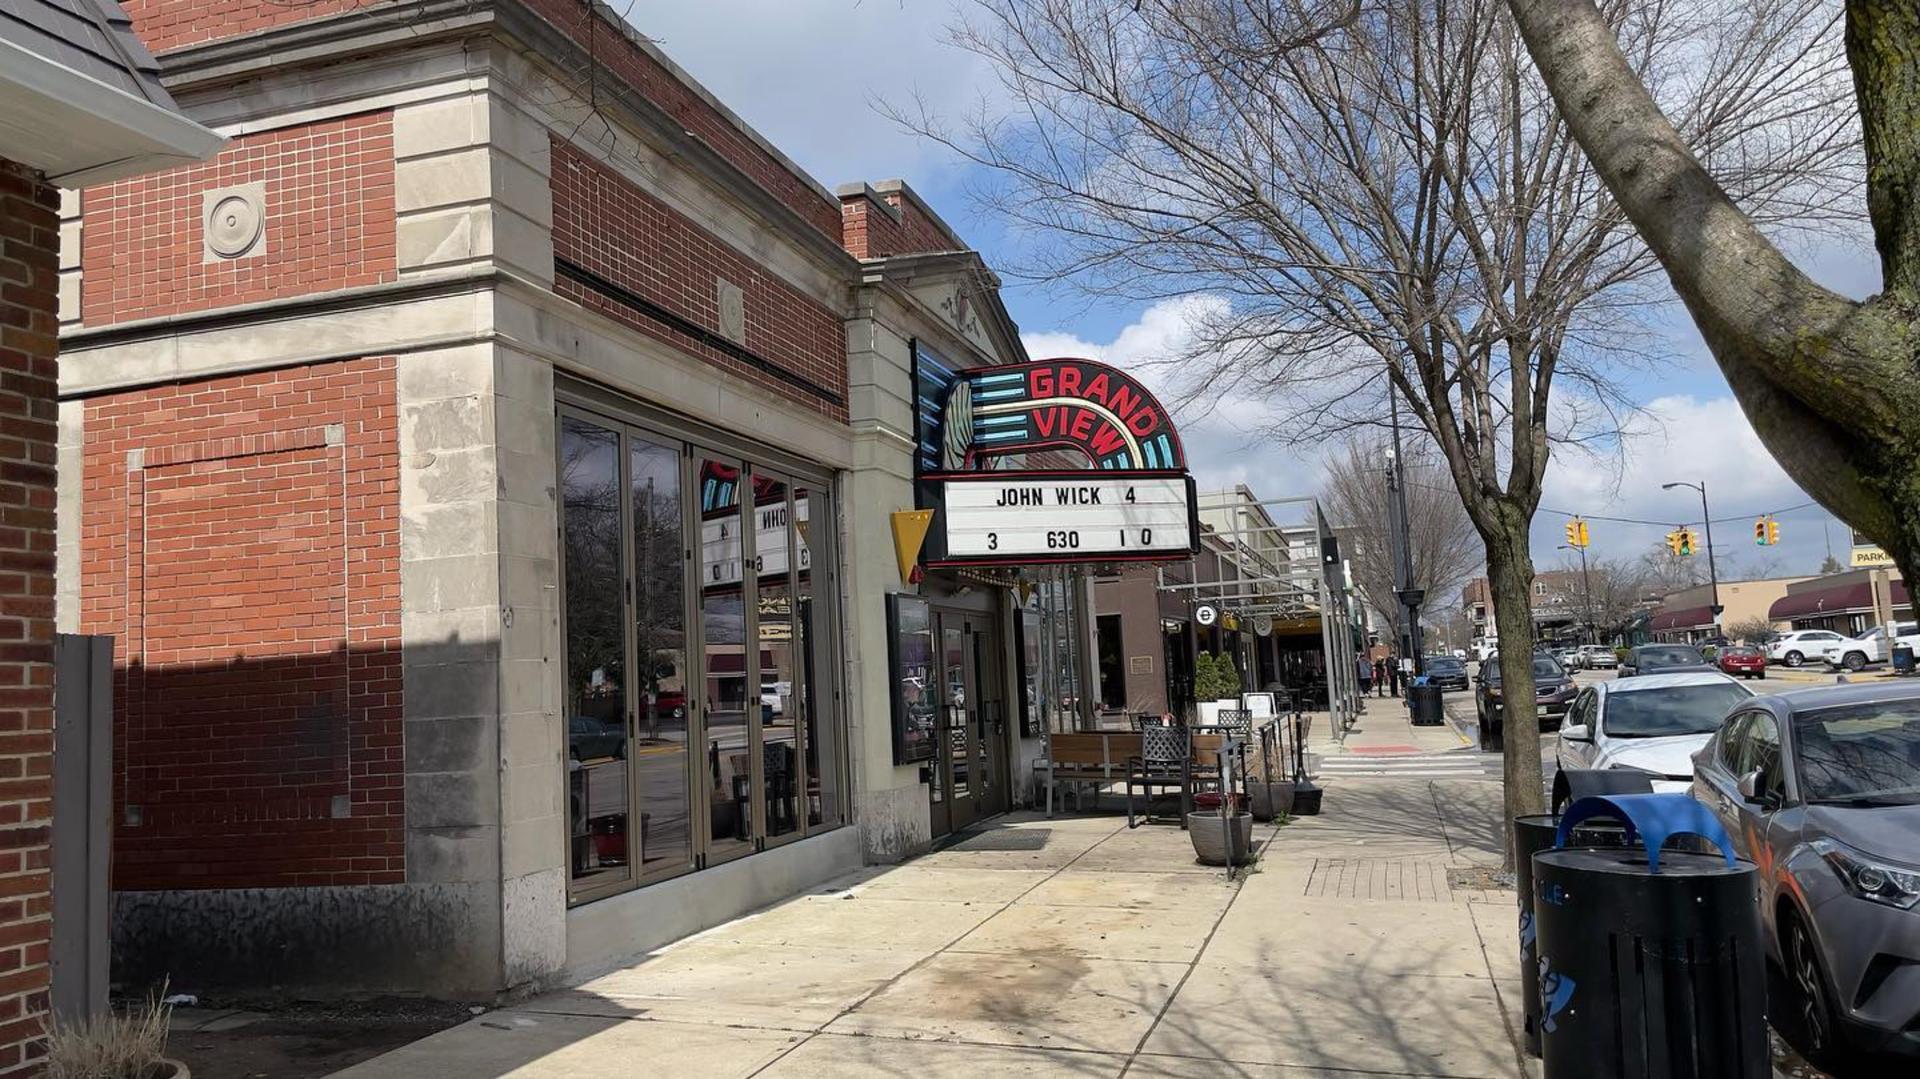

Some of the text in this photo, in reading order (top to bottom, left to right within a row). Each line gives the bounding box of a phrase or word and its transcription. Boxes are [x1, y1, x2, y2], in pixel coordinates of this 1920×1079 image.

[1030, 367, 1158, 437] GRAND
[1032, 407, 1126, 456] VIEW
[996, 486, 1136, 507] JOHN WICK 4
[987, 532, 998, 550] 3
[1047, 530, 1079, 549] 630
[1857, 552, 1889, 562] PARK
